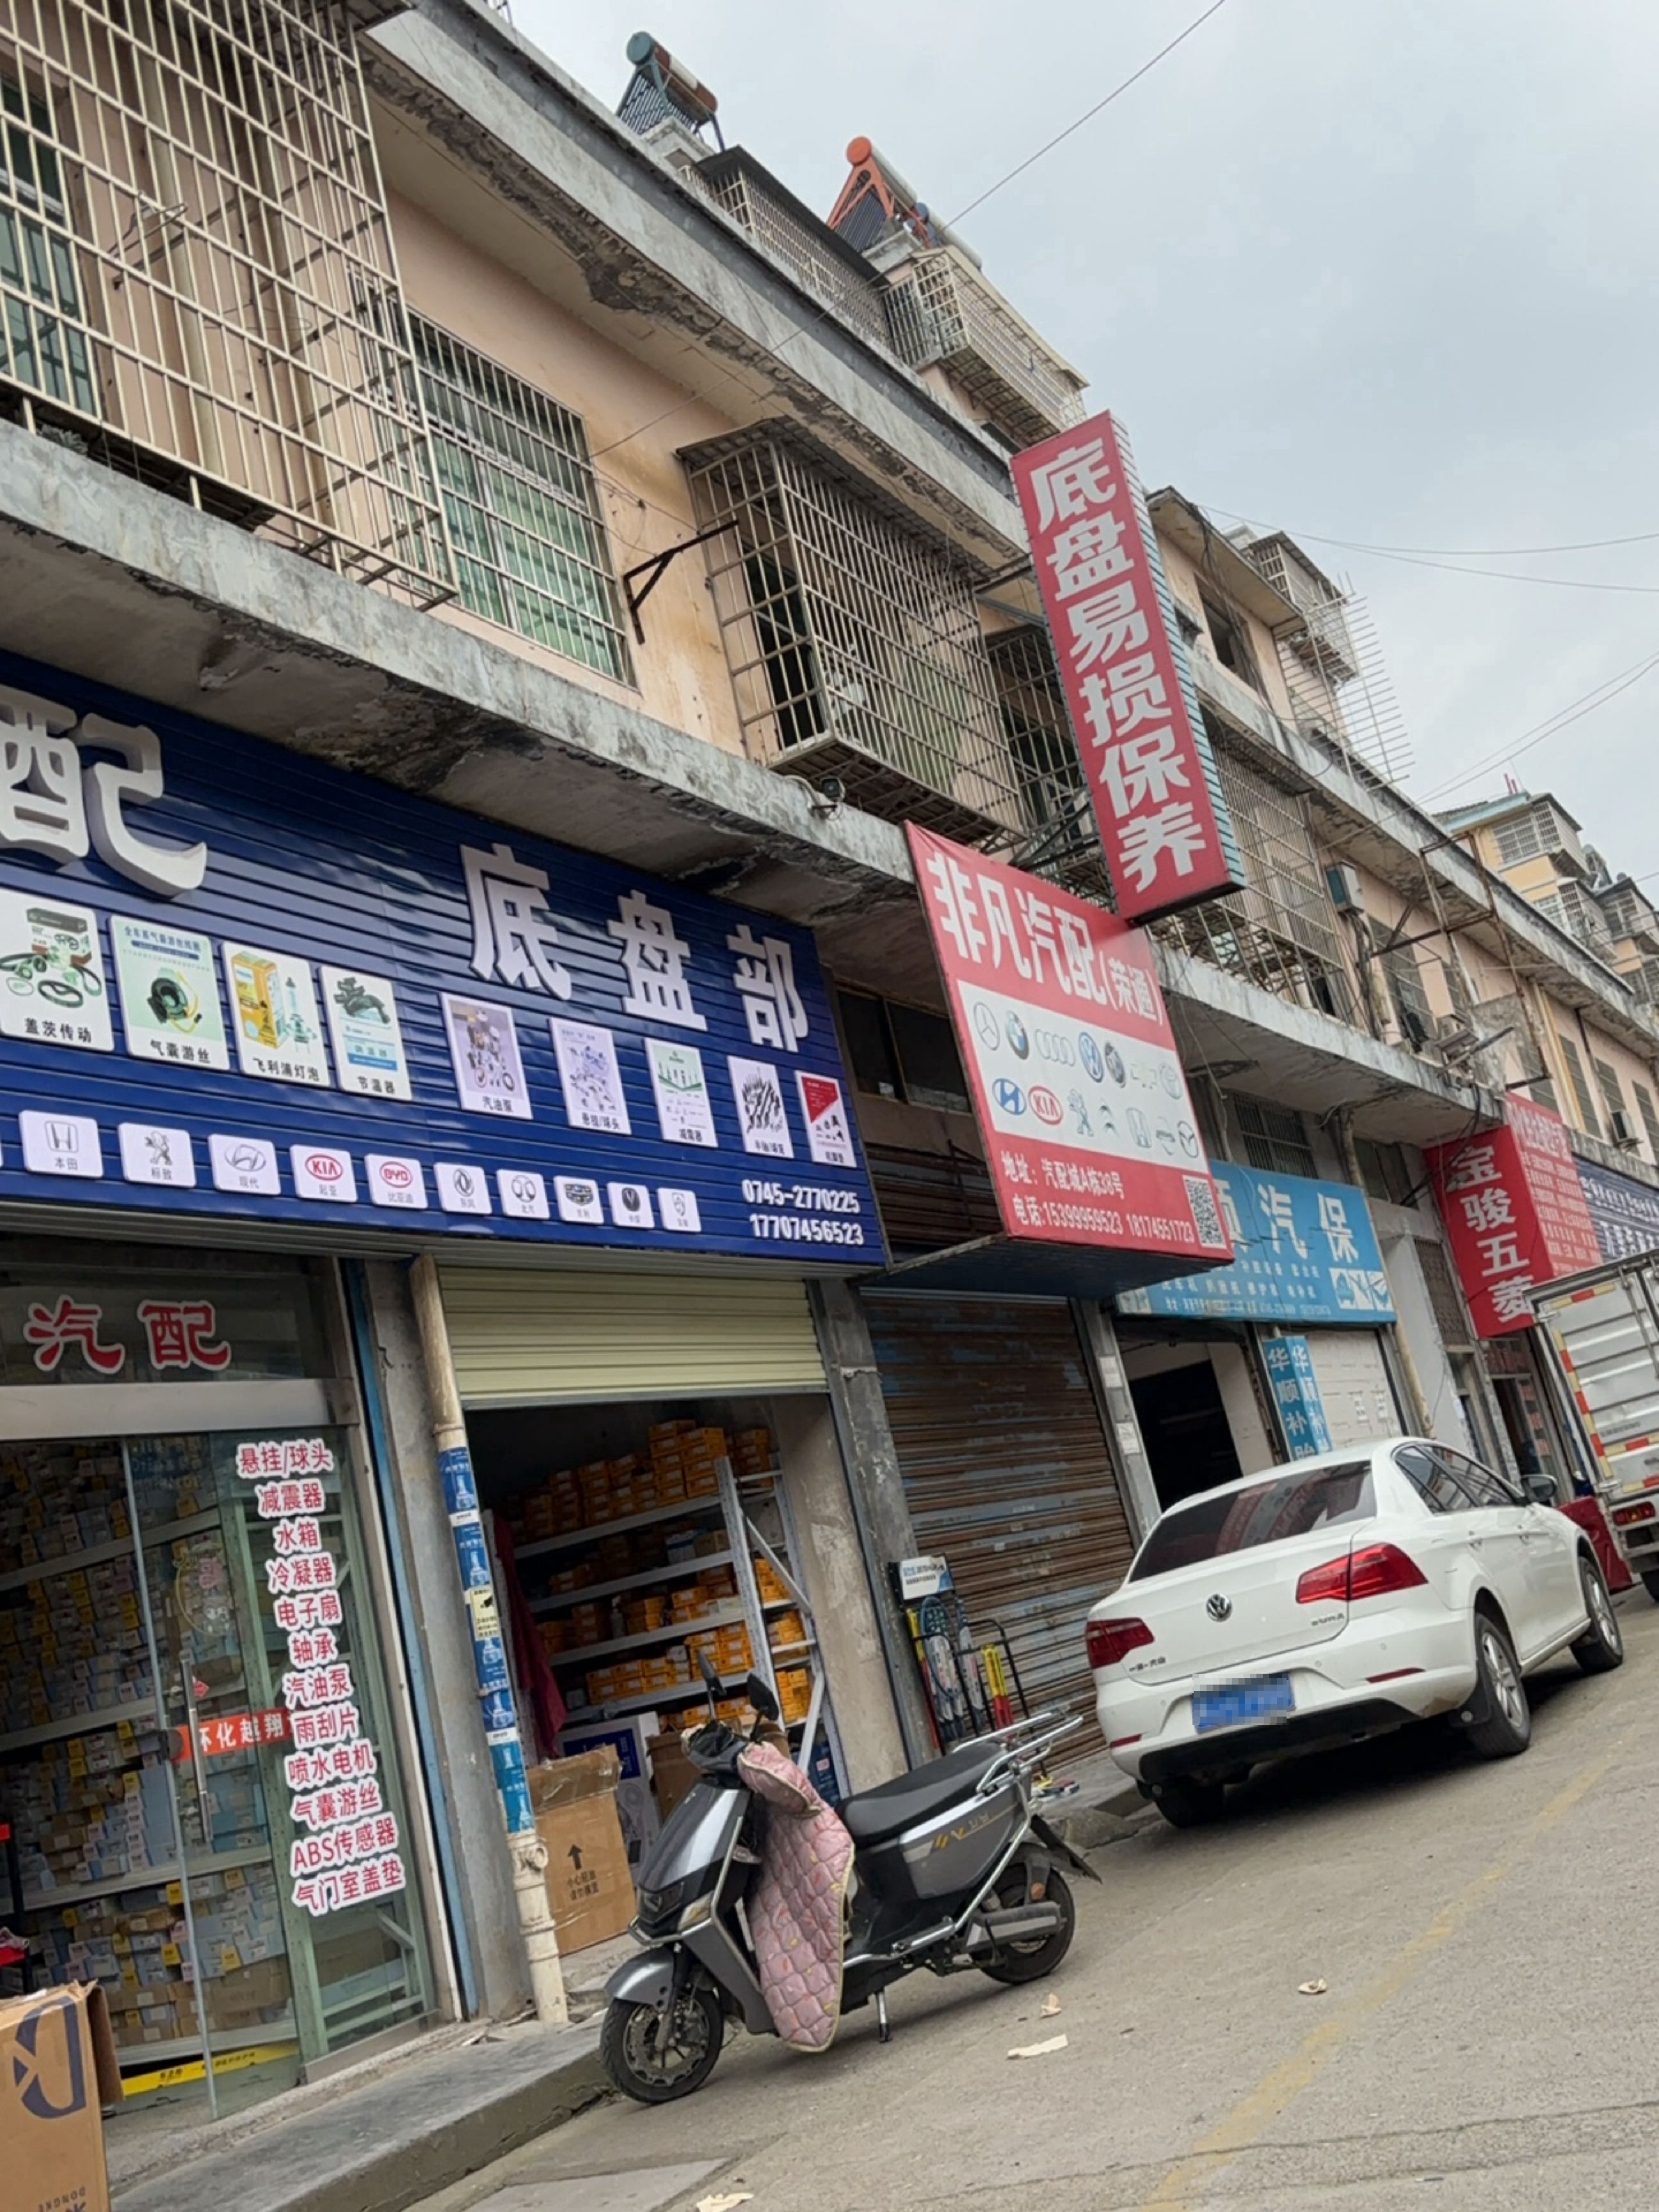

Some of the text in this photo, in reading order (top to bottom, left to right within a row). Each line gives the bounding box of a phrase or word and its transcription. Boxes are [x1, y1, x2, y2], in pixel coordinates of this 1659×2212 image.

[1029, 437, 1206, 894] 底盘易损保养
[0, 685, 207, 896] 配
[459, 842, 808, 1053] 底盘部
[24, 1018, 92, 1043] 盖茨传动
[150, 1039, 211, 1064] 气囊游丝
[252, 1057, 319, 1082] 飞利浦灯泡
[357, 1075, 395, 1094] 节温器
[54, 1157, 78, 1171] 本田
[312, 1160, 338, 1176] KIA
[383, 1167, 410, 1182] BYD
[741, 1179, 861, 1214] 0745-2770225
[749, 1212, 865, 1246] 17707456523
[1445, 1145, 1534, 1323] 宝骏五菱
[26, 1296, 230, 1372] 汽配
[239, 1441, 332, 1476] 悬挂/球头
[258, 1480, 323, 1516] 减震器
[275, 1519, 319, 1550] 水箱
[268, 1553, 333, 1591] 冷凝器
[276, 1591, 342, 1628] 电子扇
[289, 1633, 337, 1665] 轴承
[284, 1665, 351, 1708] 汽油泵
[198, 1711, 291, 1752] 怀化越翔
[292, 1703, 357, 1747] 雨刮片
[287, 1740, 374, 1788] 喷水电机
[293, 1784, 382, 1829] 气囊游丝
[293, 1813, 398, 1875] ABS传感器
[293, 1855, 405, 1914] 气门室盖垫
